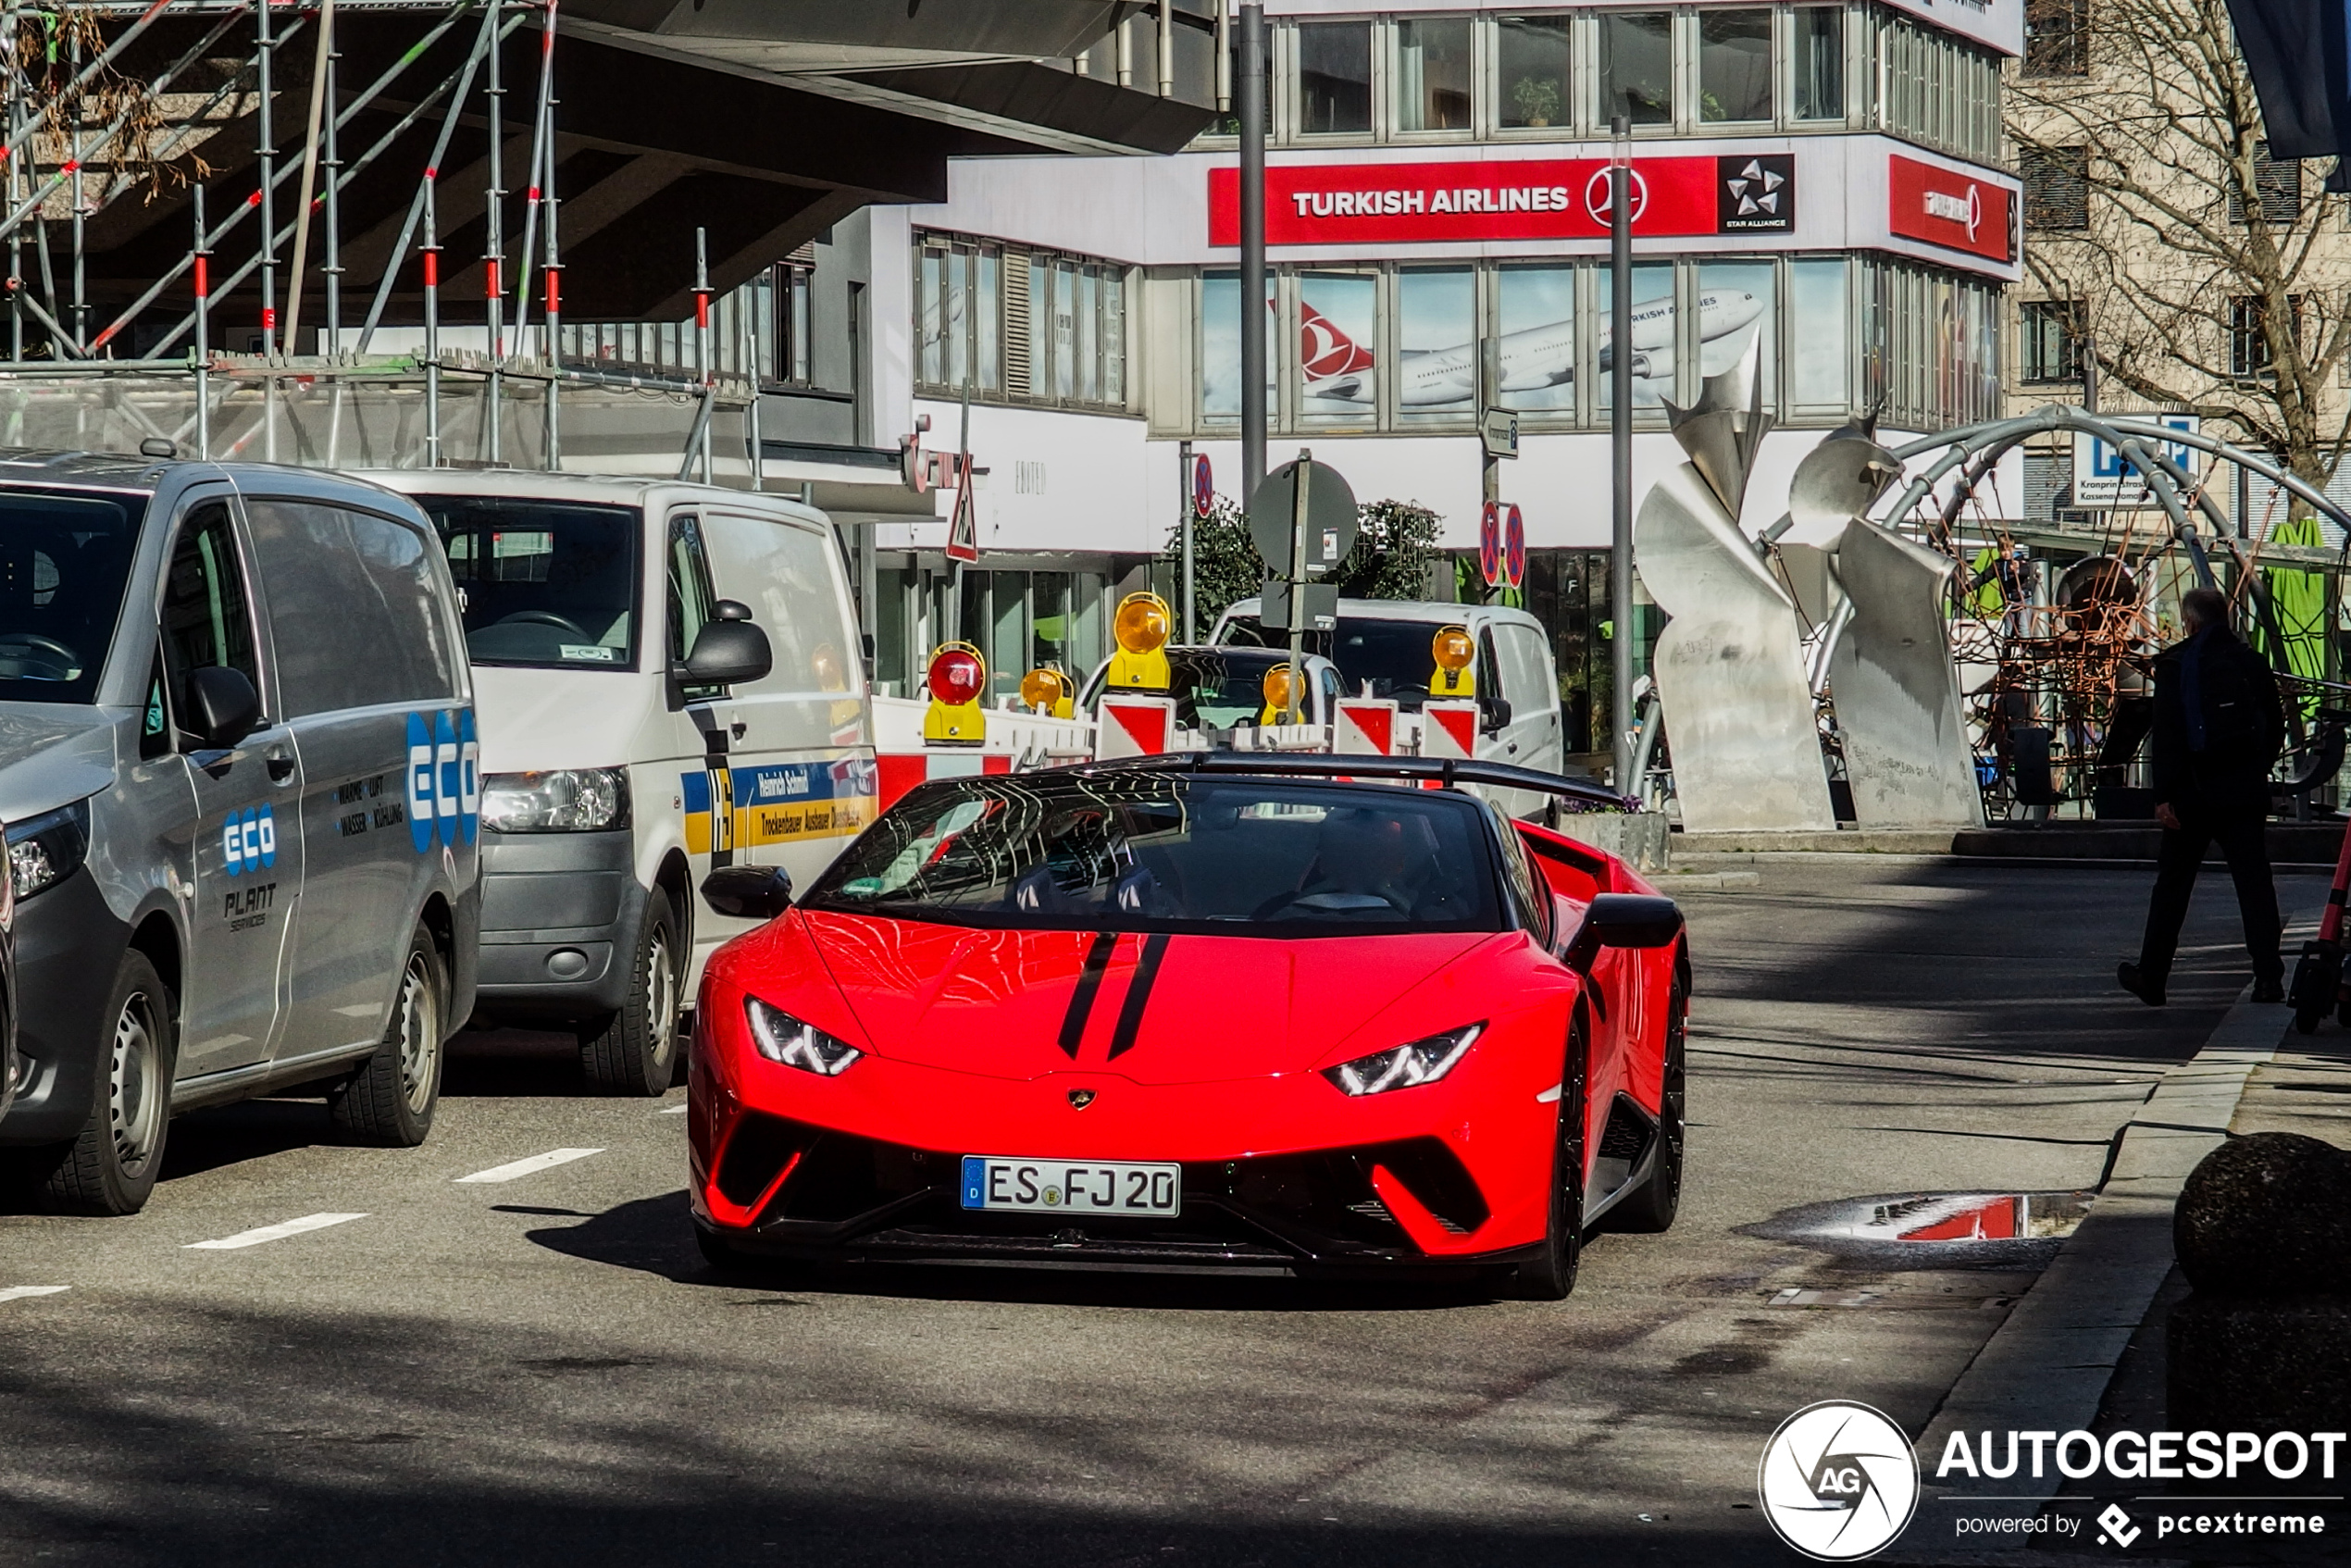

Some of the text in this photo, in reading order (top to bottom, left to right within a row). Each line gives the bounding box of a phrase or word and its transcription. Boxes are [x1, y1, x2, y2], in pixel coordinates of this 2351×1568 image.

[1293, 187, 1569, 216] TURKISH AIRLINES
[1748, 219, 1786, 228] ALLIANCE
[369, 776, 384, 798] LUFT
[409, 741, 479, 820] ECO
[757, 769, 809, 798] Heinrich Schmid
[341, 802, 403, 837] WASSER KÜHLUNG
[761, 810, 802, 837] Trockenbauer
[804, 807, 830, 831] Ausbauer
[224, 817, 276, 862] ECO
[224, 882, 277, 918] PLANT
[970, 1188, 978, 1199] D
[989, 1164, 1039, 1204] ES
[1125, 1171, 1175, 1209] 20
